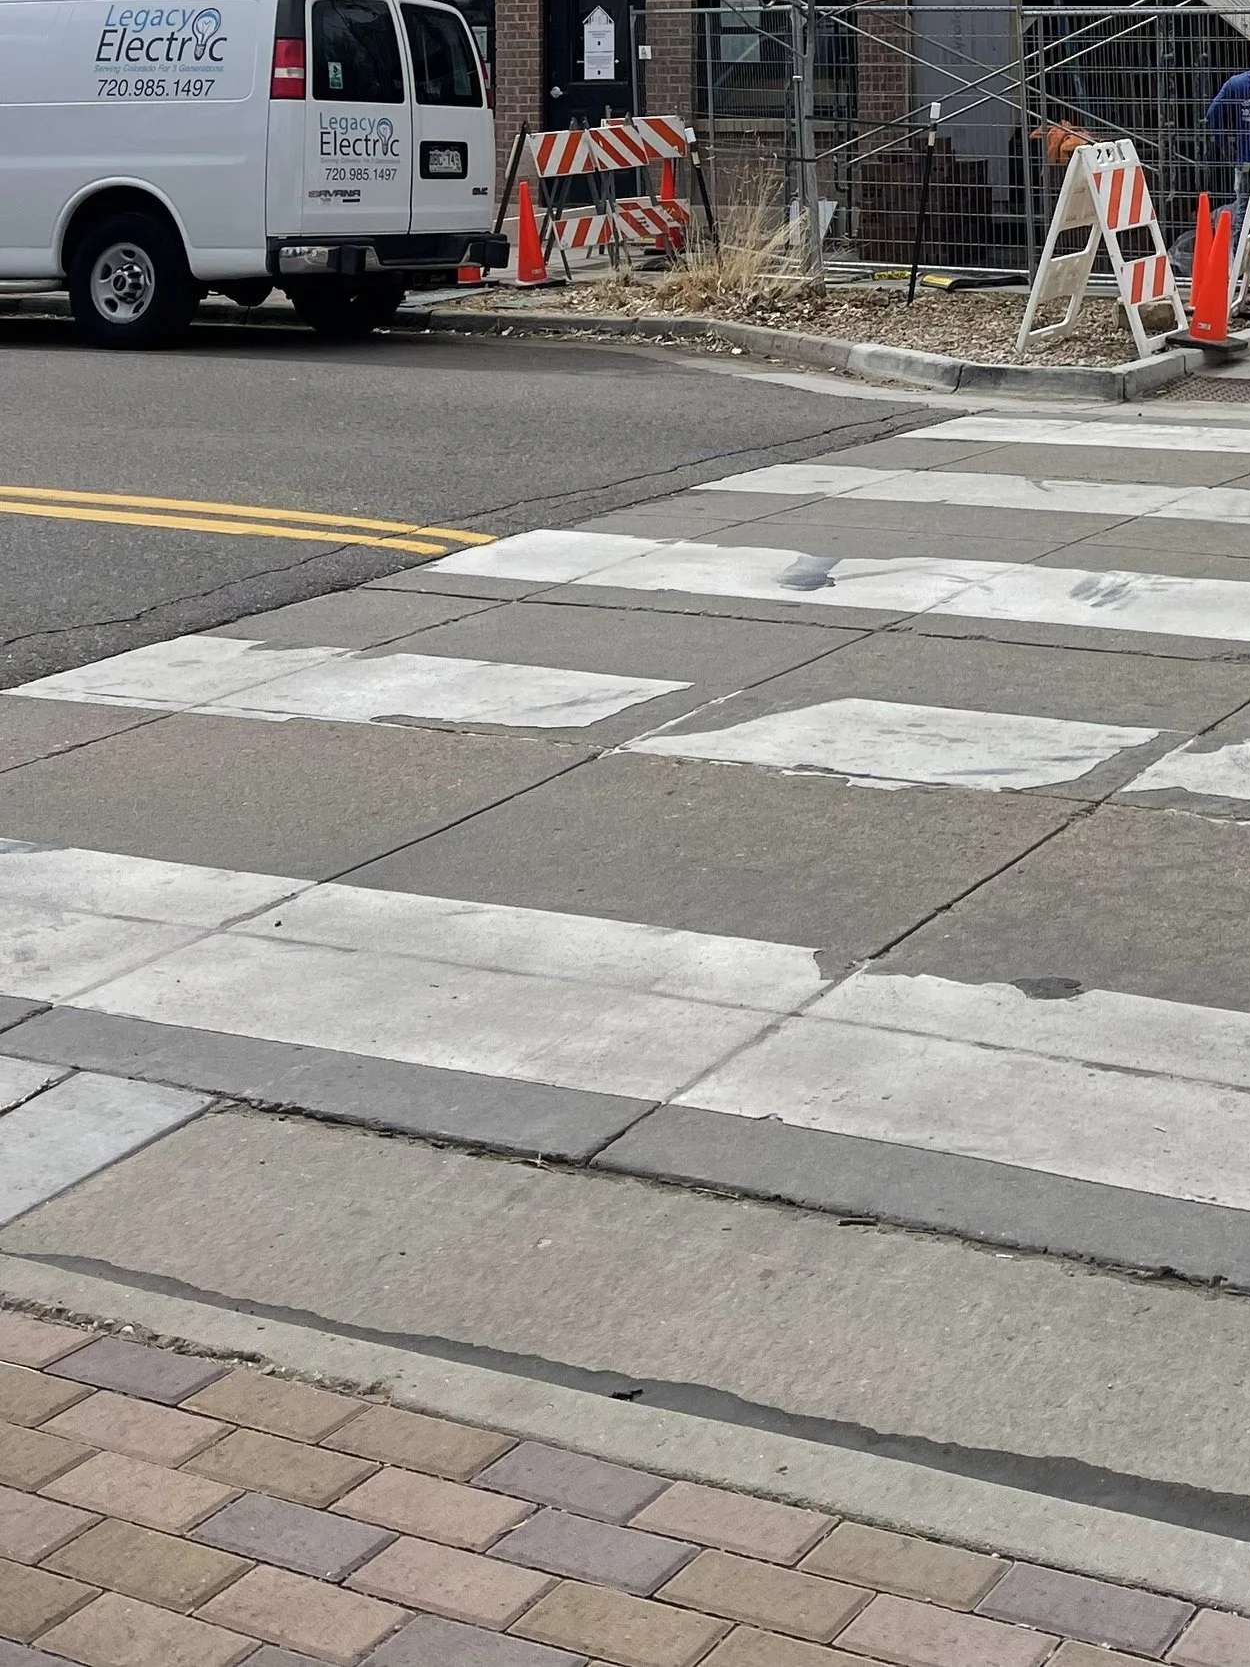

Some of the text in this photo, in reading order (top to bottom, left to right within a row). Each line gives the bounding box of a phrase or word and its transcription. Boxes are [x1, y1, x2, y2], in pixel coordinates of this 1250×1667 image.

[105, 4, 195, 33] Legacy
[95, 27, 228, 62] Electric
[97, 79, 215, 96] 720.985.1497
[319, 112, 376, 136] Legacy
[320, 130, 400, 157] Electric
[325, 168, 398, 181] 720.985.1497
